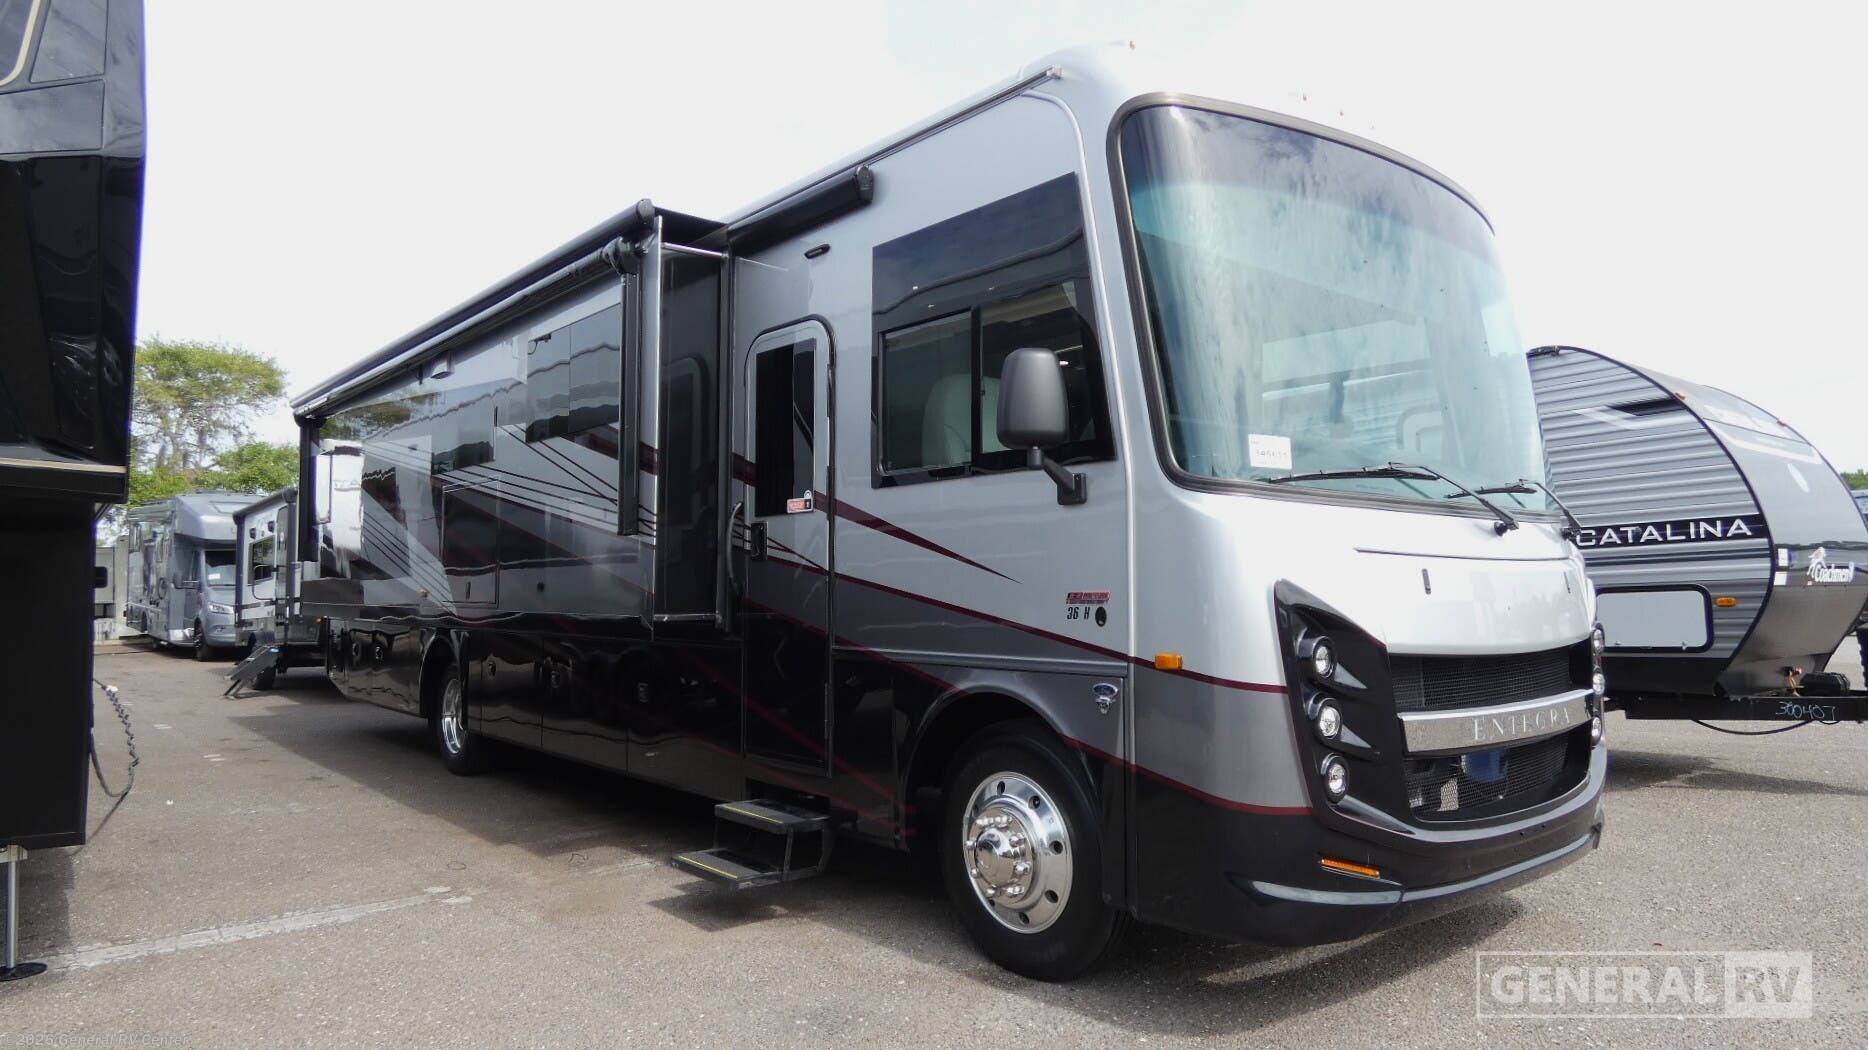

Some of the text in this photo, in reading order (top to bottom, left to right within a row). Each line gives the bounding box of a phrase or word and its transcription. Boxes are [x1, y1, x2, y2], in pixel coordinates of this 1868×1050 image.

[1575, 518, 1753, 547] CATALINA
[1066, 606, 1091, 620] 36 H
[1472, 706, 1571, 741] ENTEGRA
